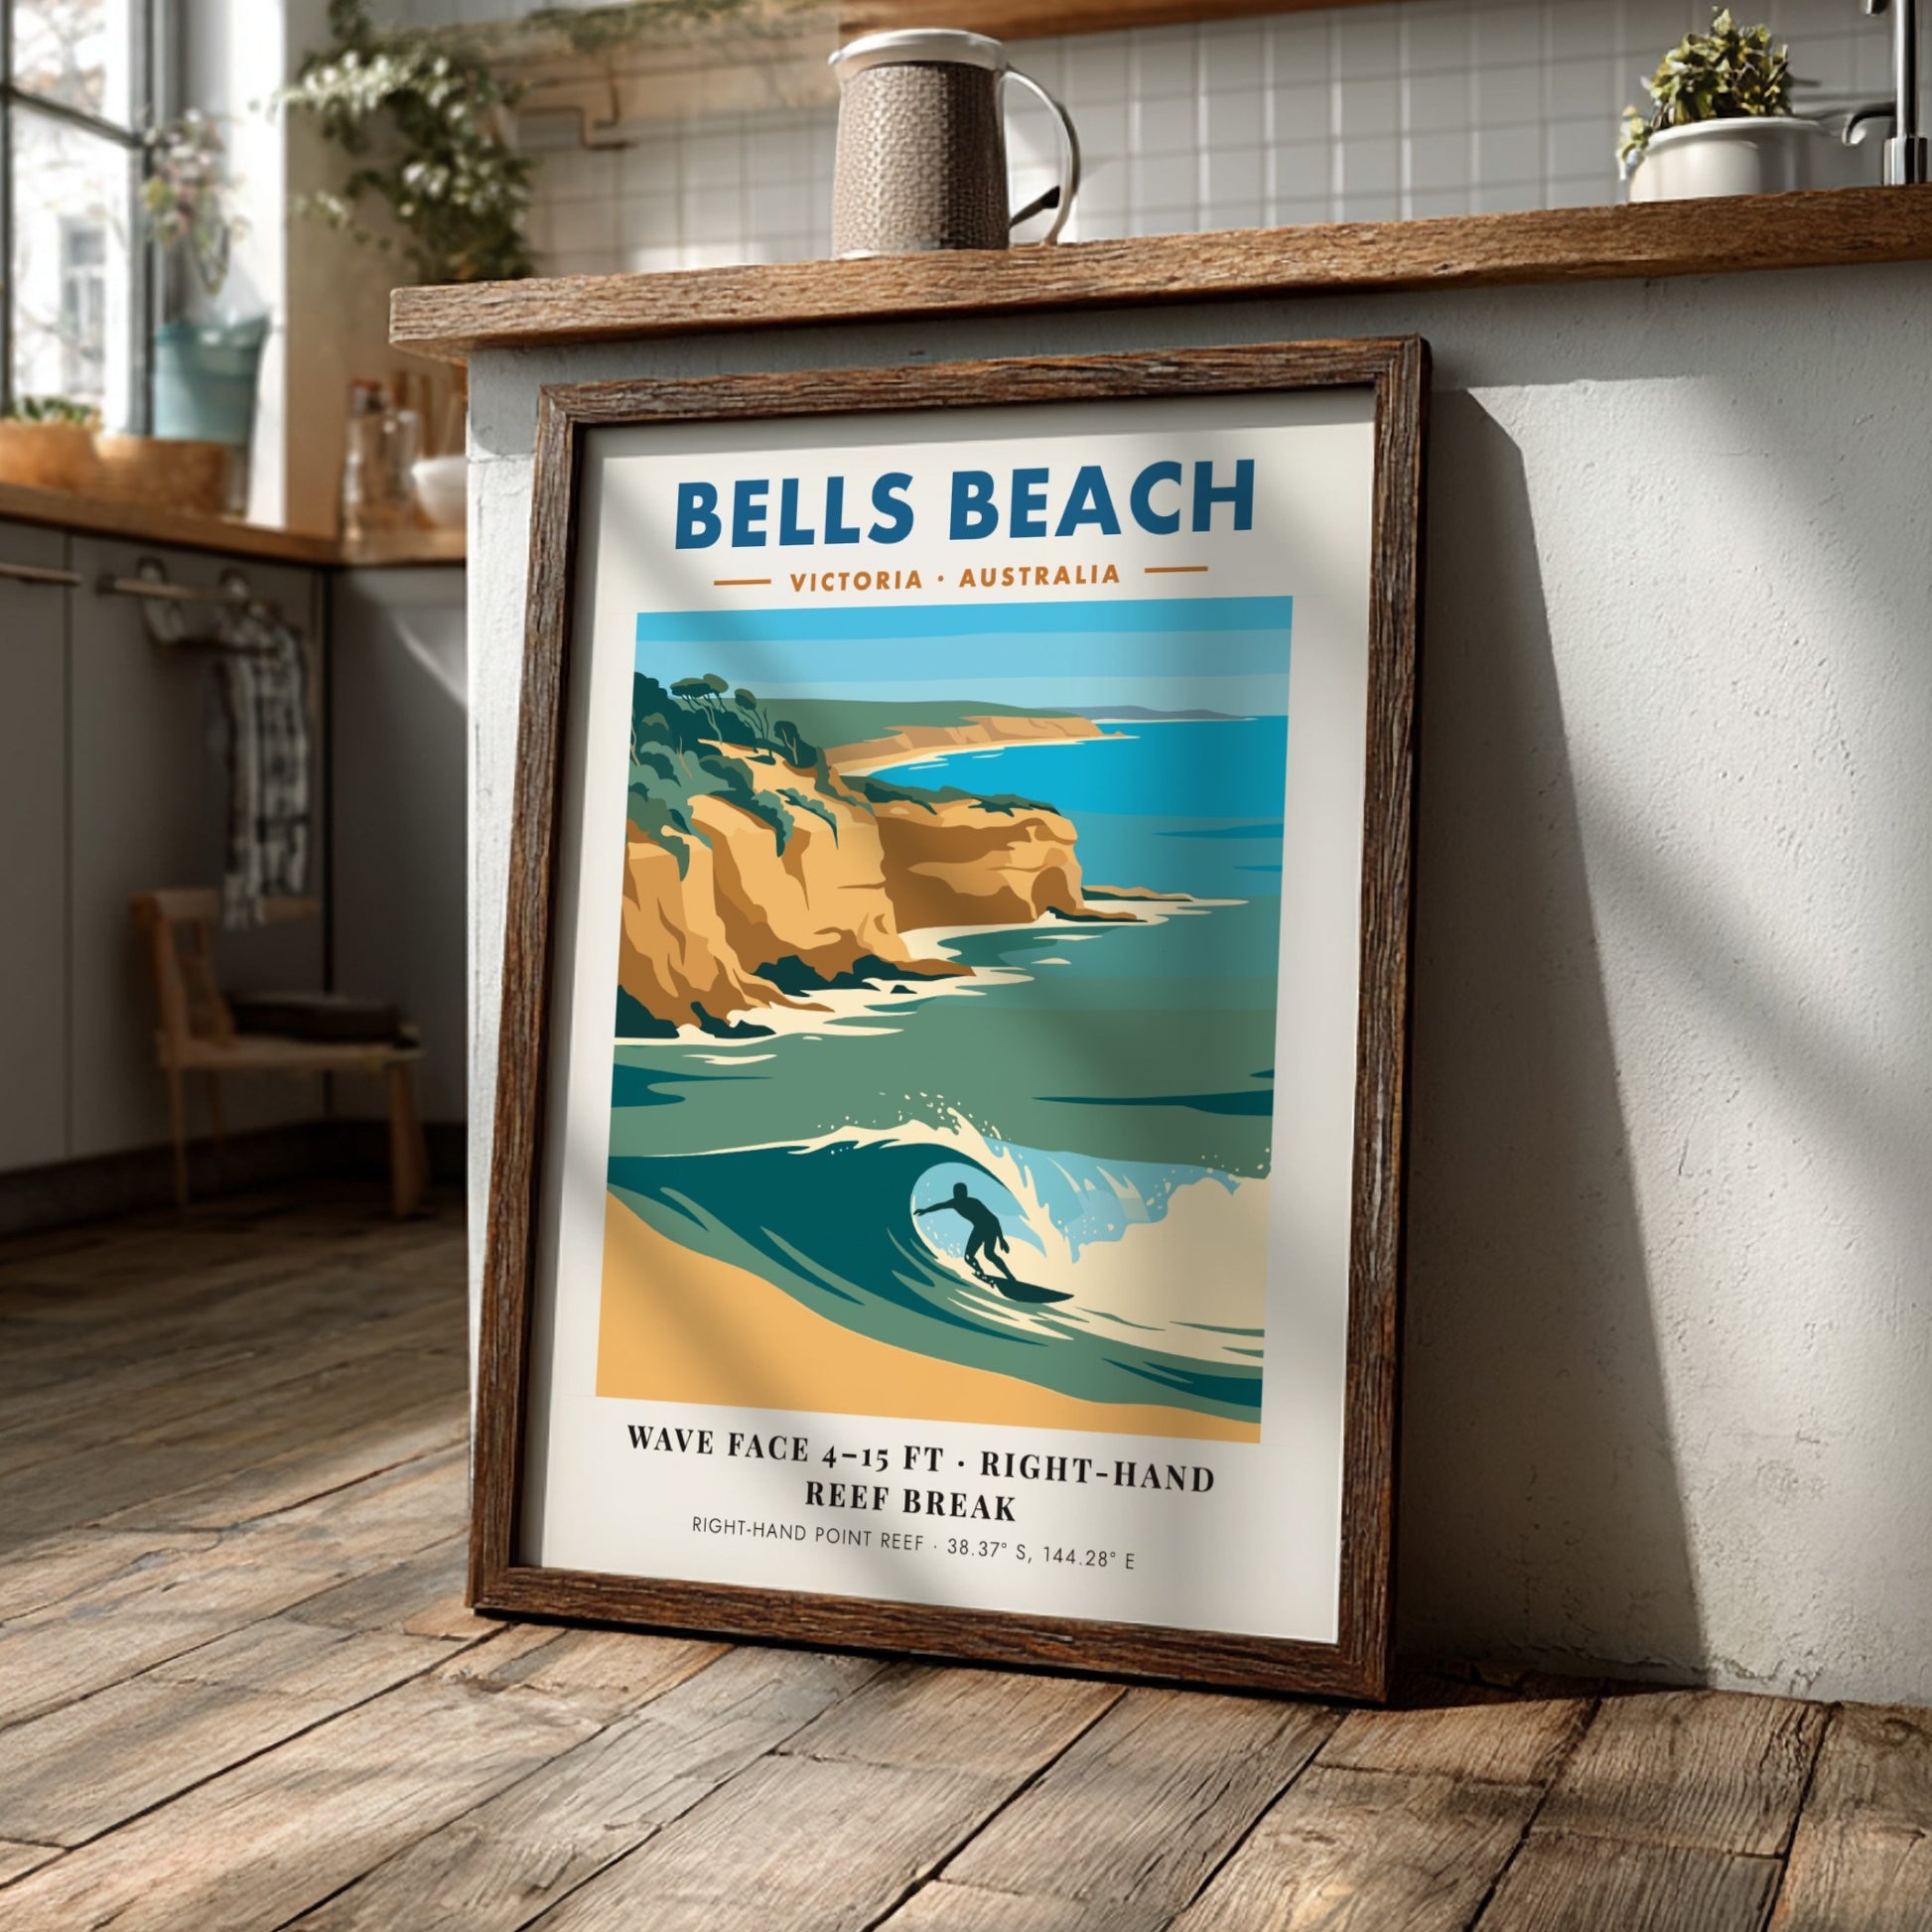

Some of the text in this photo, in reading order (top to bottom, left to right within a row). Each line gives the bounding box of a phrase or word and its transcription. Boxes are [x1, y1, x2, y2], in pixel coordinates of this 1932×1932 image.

[674, 458, 1255, 551] BELLS BEACH
[789, 563, 1121, 594] VICTORIA AUSTRALIA
[626, 1424, 714, 1455] WAVE
[727, 1431, 809, 1463] FACE
[902, 1445, 944, 1473] FT
[979, 1449, 1215, 1493] RIGHT-HAND
[804, 1479, 1017, 1523] REEF BREAK
[691, 1515, 1135, 1571] RIGHT-HAND POINT REEF 38.37° S, 144.28° E
